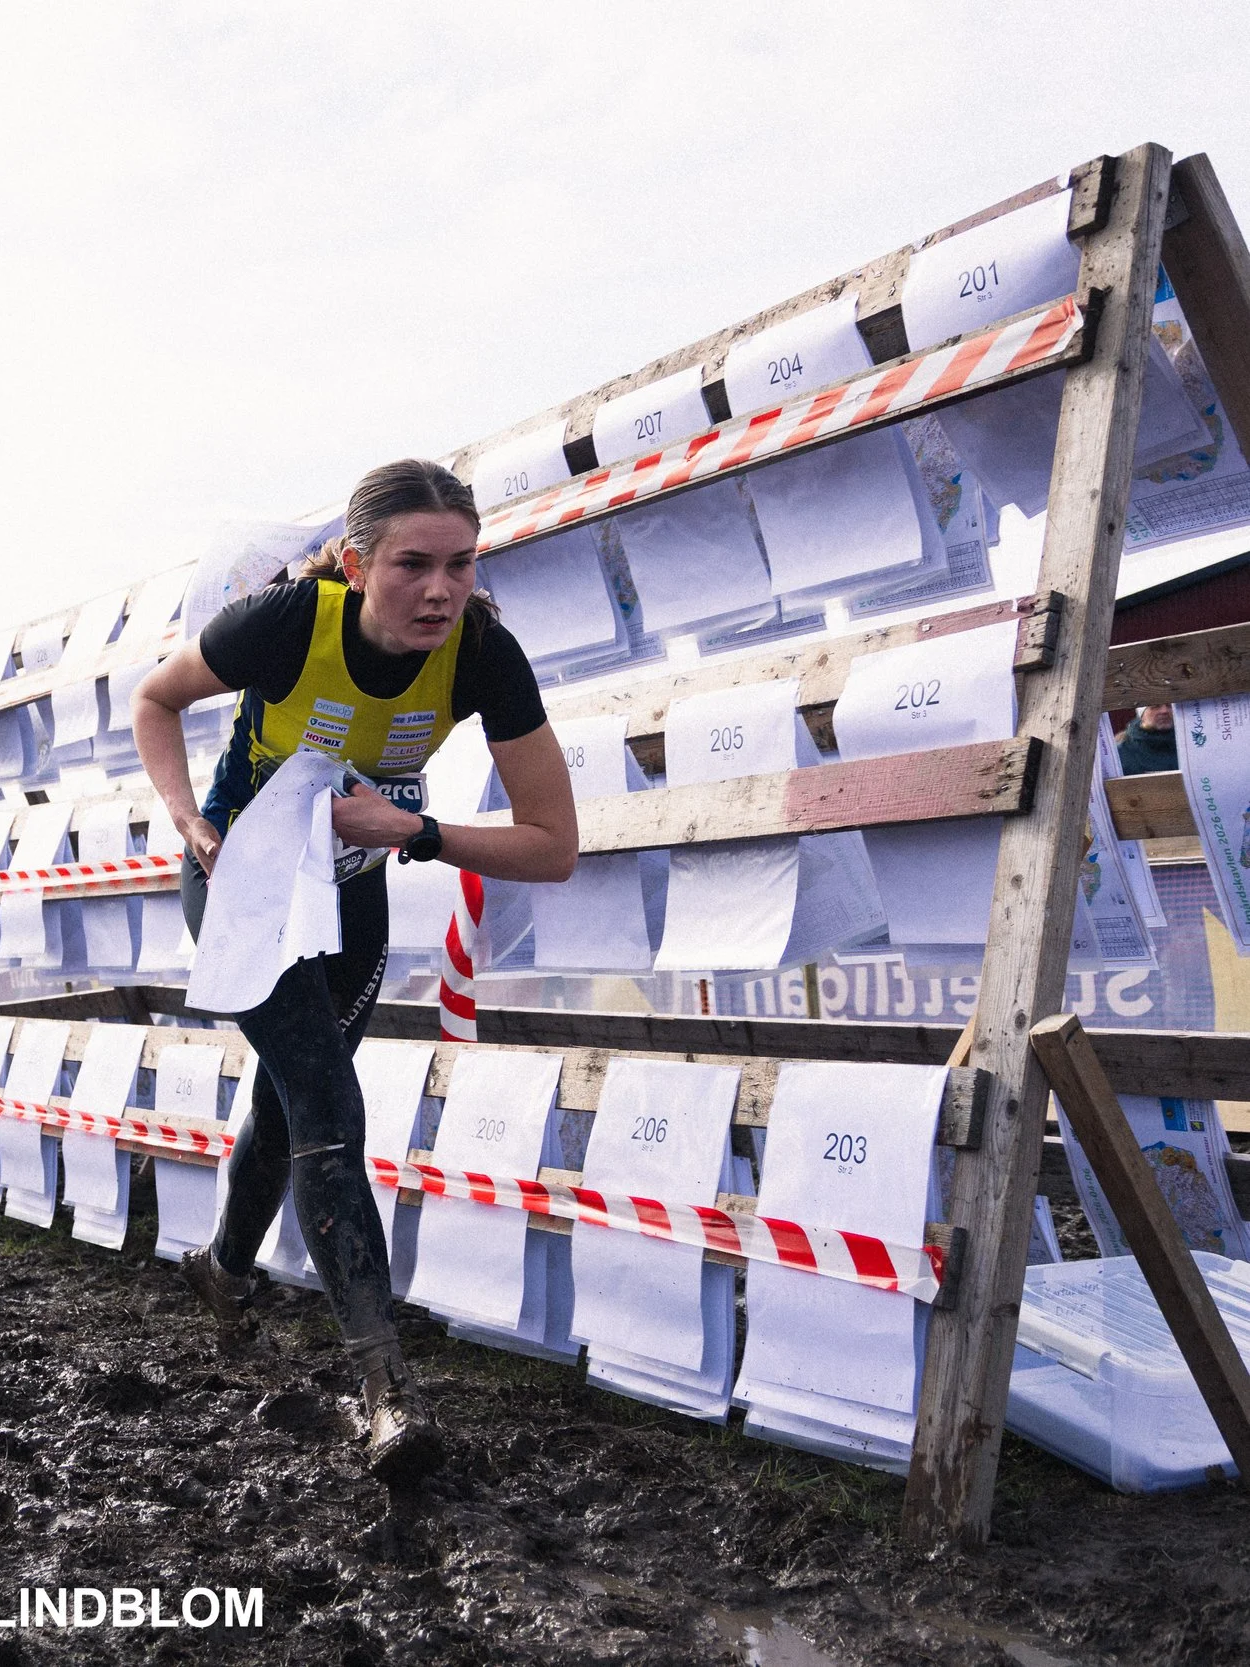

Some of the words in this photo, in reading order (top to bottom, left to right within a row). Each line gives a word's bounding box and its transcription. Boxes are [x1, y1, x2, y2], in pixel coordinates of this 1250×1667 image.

[958, 259, 999, 298] 201
[767, 352, 803, 385] 204
[634, 410, 662, 440] 207
[504, 471, 529, 497] 210
[894, 678, 942, 711] 202
[305, 731, 342, 748] HOTMIX
[317, 721, 348, 732] GEOSYNT
[709, 725, 744, 752] 205
[399, 744, 428, 755] LIETO
[1200, 776, 1229, 846] 2026-04-06
[475, 1117, 506, 1142] 209
[631, 1116, 668, 1143] 206
[823, 1132, 867, 1164] 203
